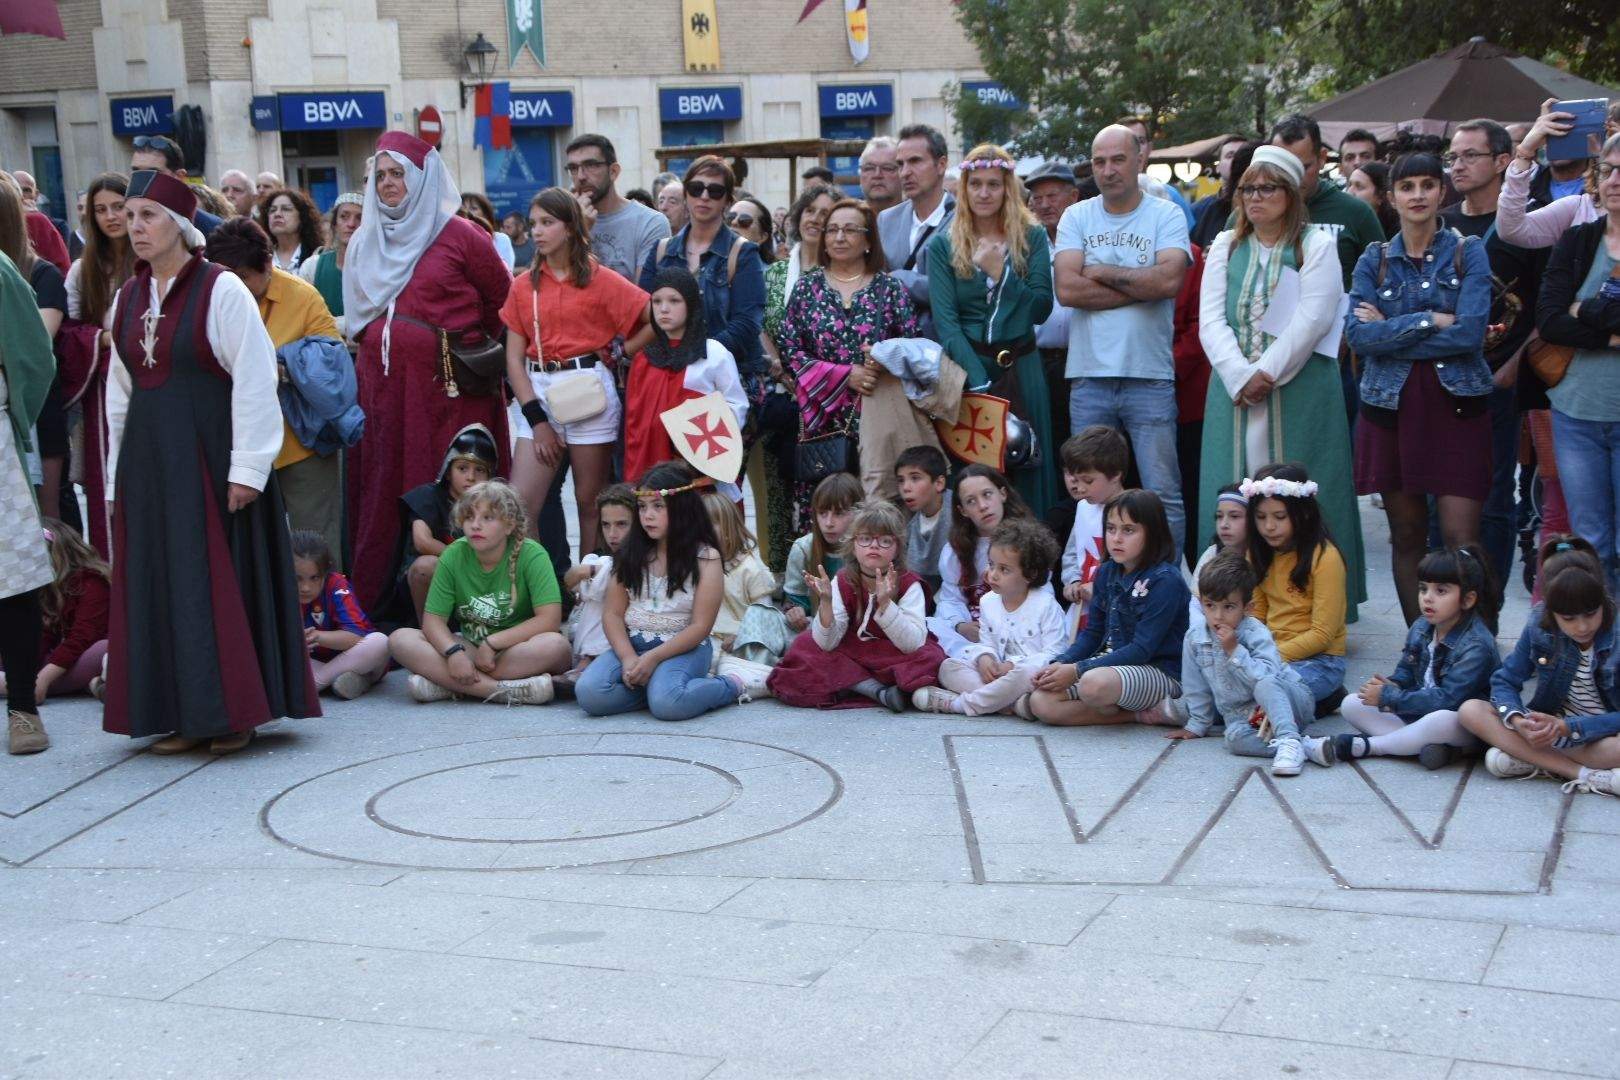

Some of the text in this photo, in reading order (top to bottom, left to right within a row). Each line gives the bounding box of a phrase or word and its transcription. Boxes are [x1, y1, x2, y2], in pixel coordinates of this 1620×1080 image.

[303, 98, 364, 123] BBVA
[678, 93, 724, 115] BBVA
[836, 90, 877, 111] BBVA
[123, 105, 159, 128] BBVA
[255, 108, 272, 120] BBVA
[1112, 232, 1152, 252] JEANS
